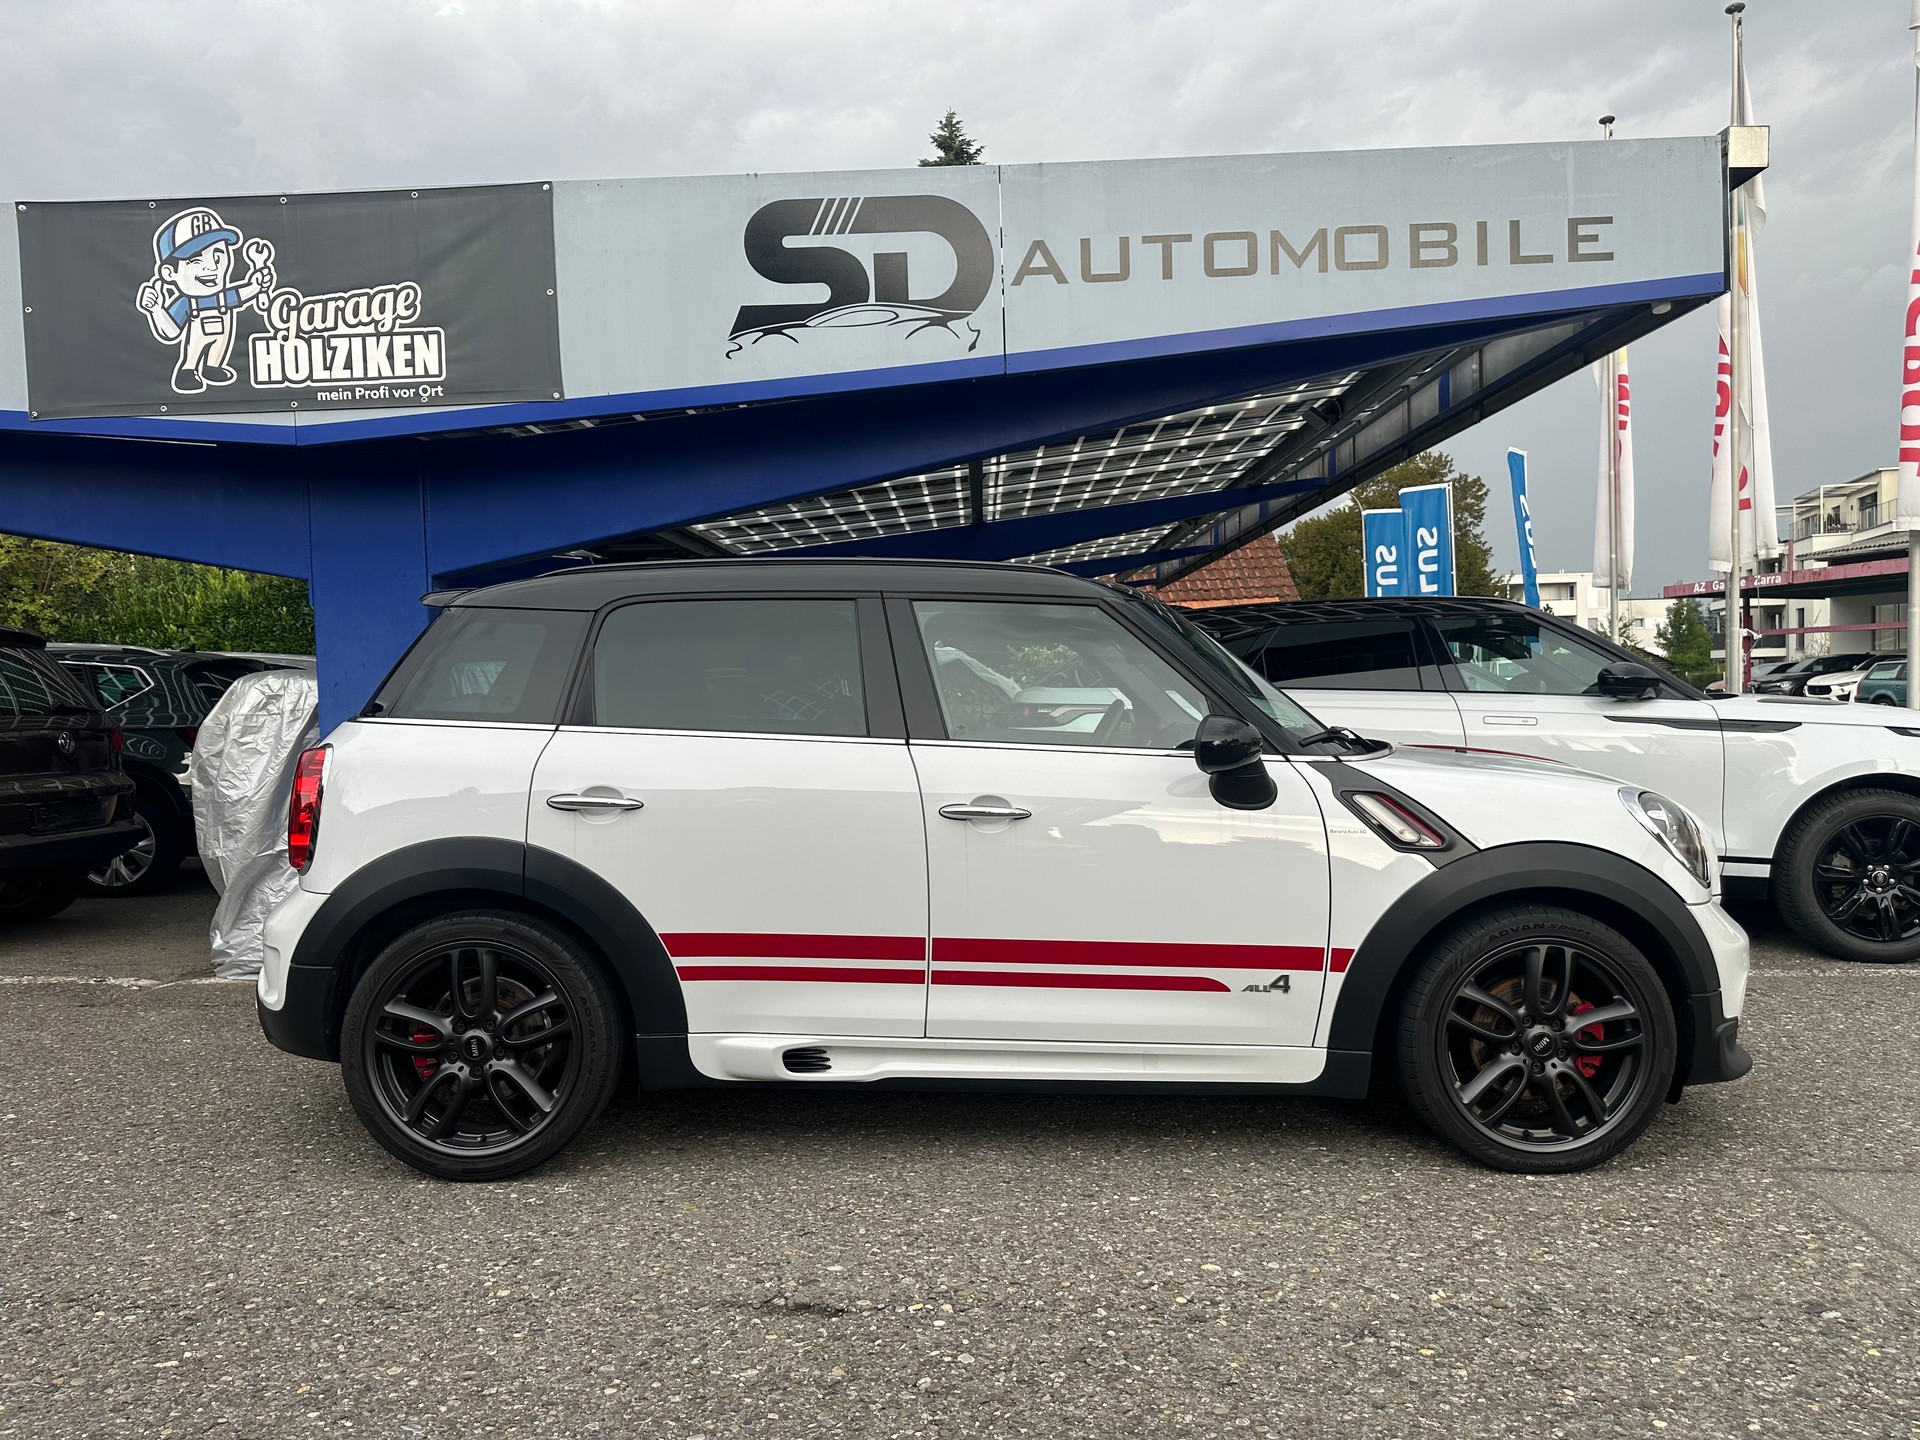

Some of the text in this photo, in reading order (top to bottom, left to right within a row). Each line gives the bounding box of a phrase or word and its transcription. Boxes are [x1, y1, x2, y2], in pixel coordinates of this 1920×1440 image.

[191, 214, 213, 238] GB
[1011, 215, 1615, 287] AUTOMOBILE
[270, 286, 418, 343] Garage
[255, 334, 440, 383] HOLZIKEN
[317, 385, 444, 401] mein Profi vor Ort
[1693, 574, 1782, 593] AZ Gae Zarra
[1488, 922, 1546, 942] ADVAN
[1241, 974, 1291, 994] ALL4
[1533, 1036, 1550, 1052] MINI
